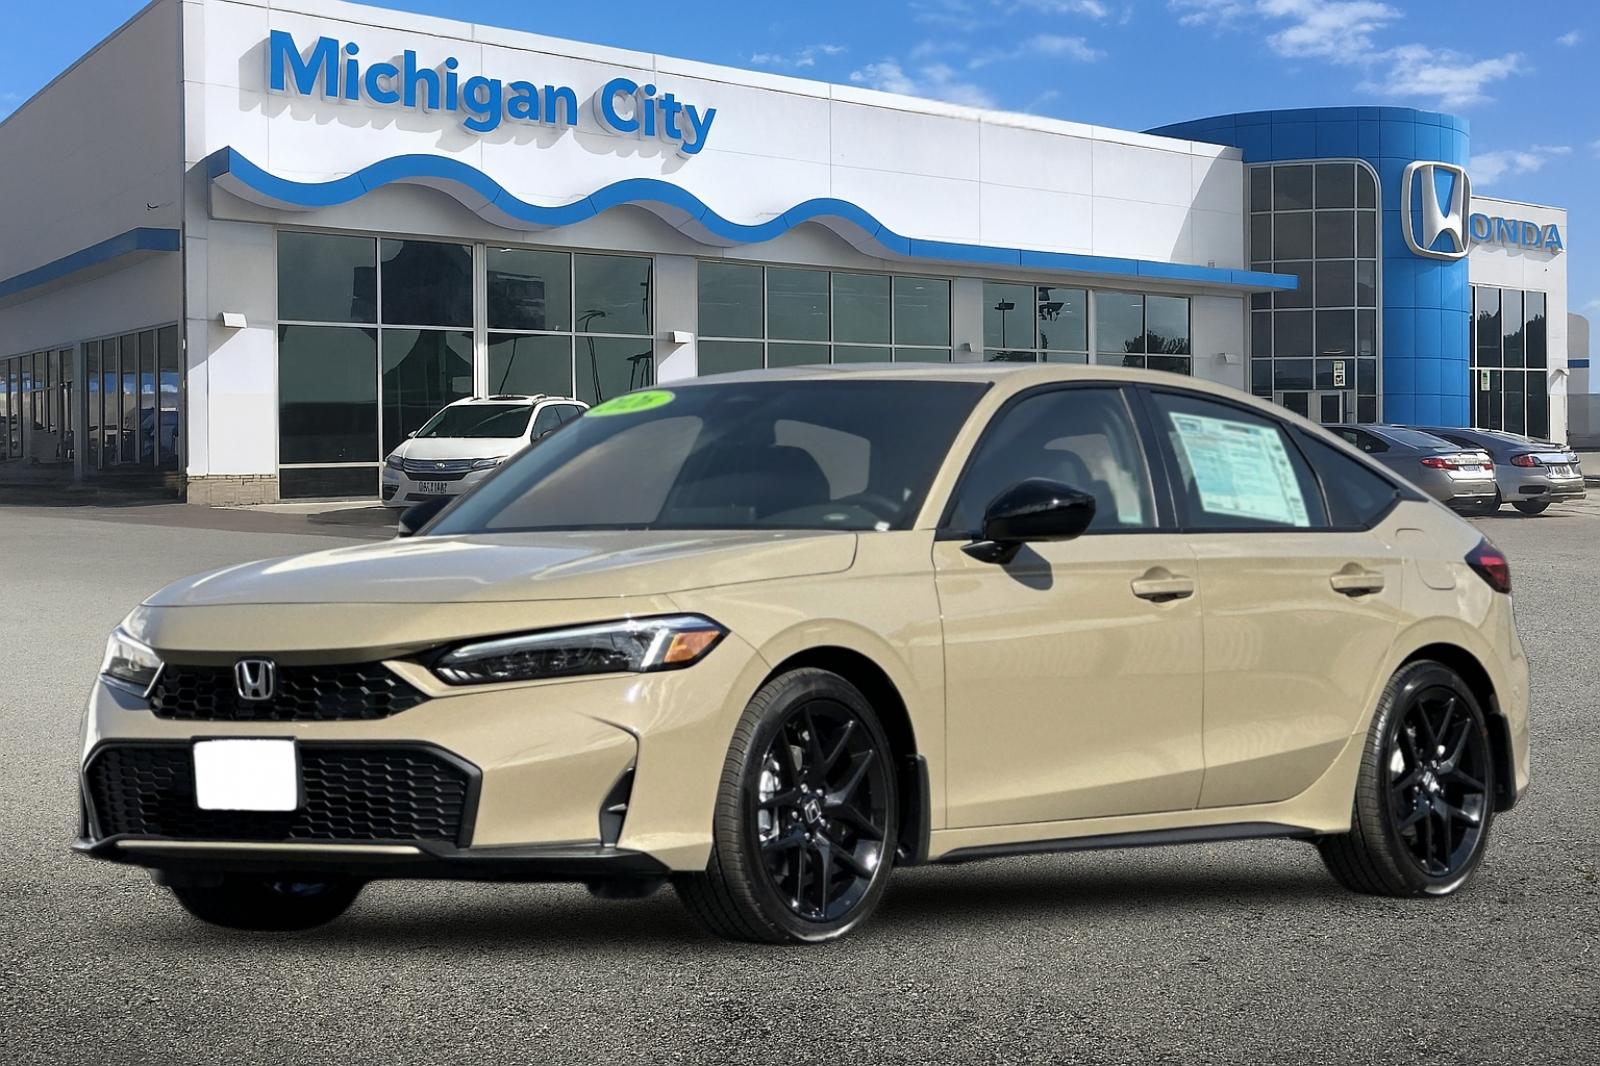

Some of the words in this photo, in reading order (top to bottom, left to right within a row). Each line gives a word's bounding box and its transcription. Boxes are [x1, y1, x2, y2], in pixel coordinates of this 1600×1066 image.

[269, 30, 578, 133] Michigan
[600, 77, 717, 155] City
[1470, 213, 1564, 249] ONDA
